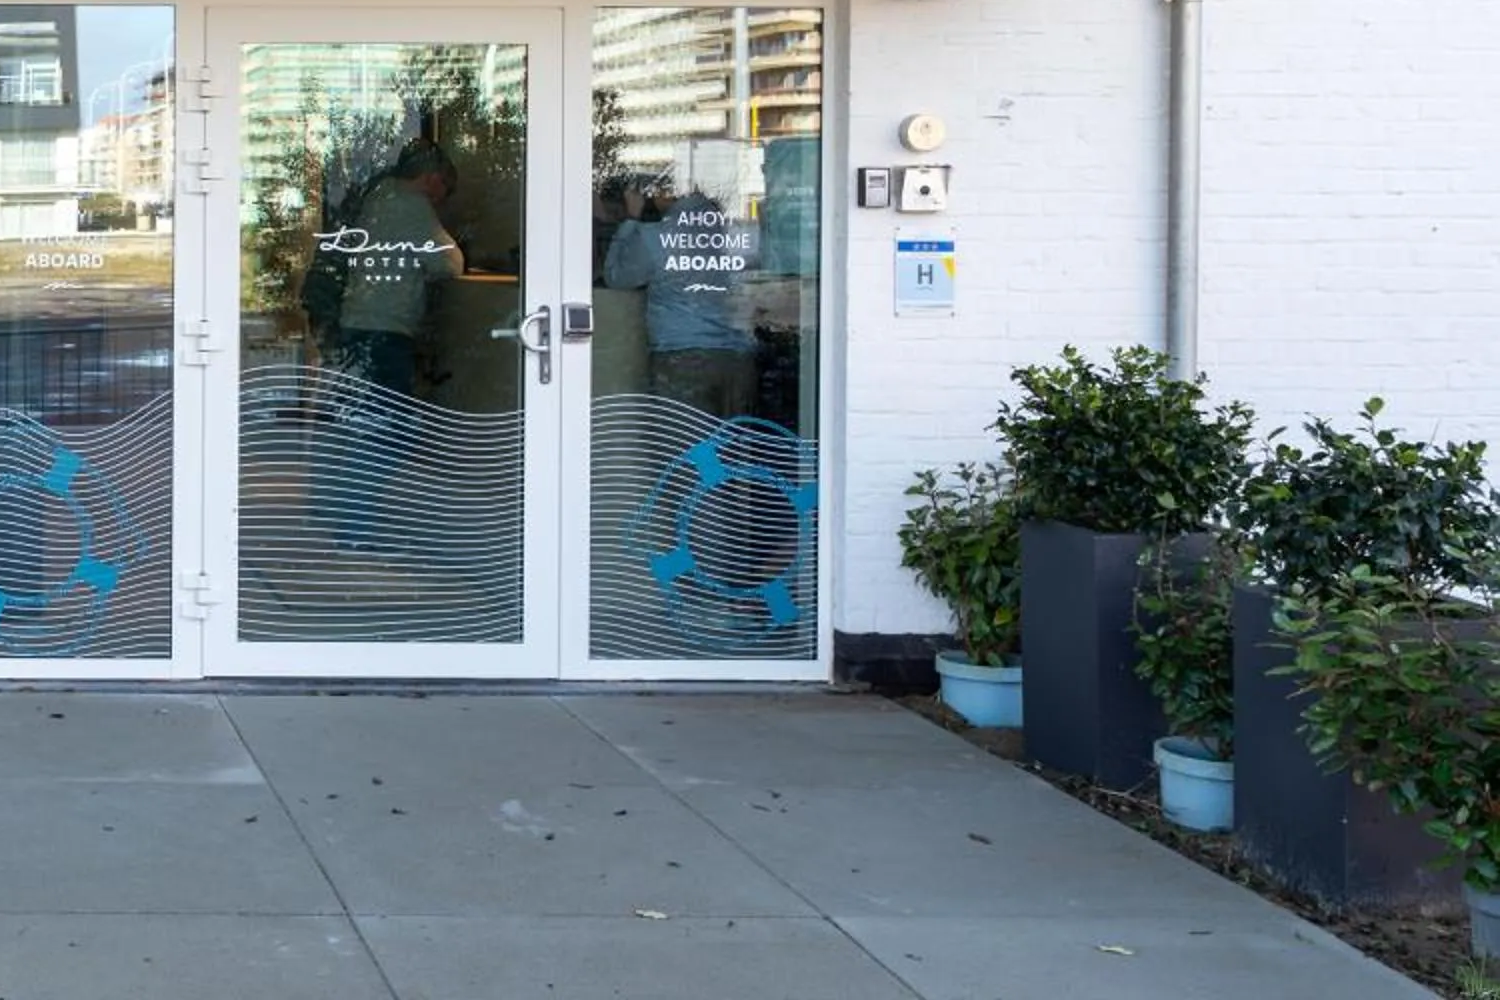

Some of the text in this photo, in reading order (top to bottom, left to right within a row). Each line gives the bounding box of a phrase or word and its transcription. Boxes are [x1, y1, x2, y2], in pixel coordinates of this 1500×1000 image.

[313, 225, 455, 252] Dune
[659, 233, 751, 248] WELCOME
[25, 253, 104, 269] ABOARD
[348, 257, 421, 267] HOTEL
[664, 255, 745, 271] ABOARD
[917, 264, 933, 285] H
